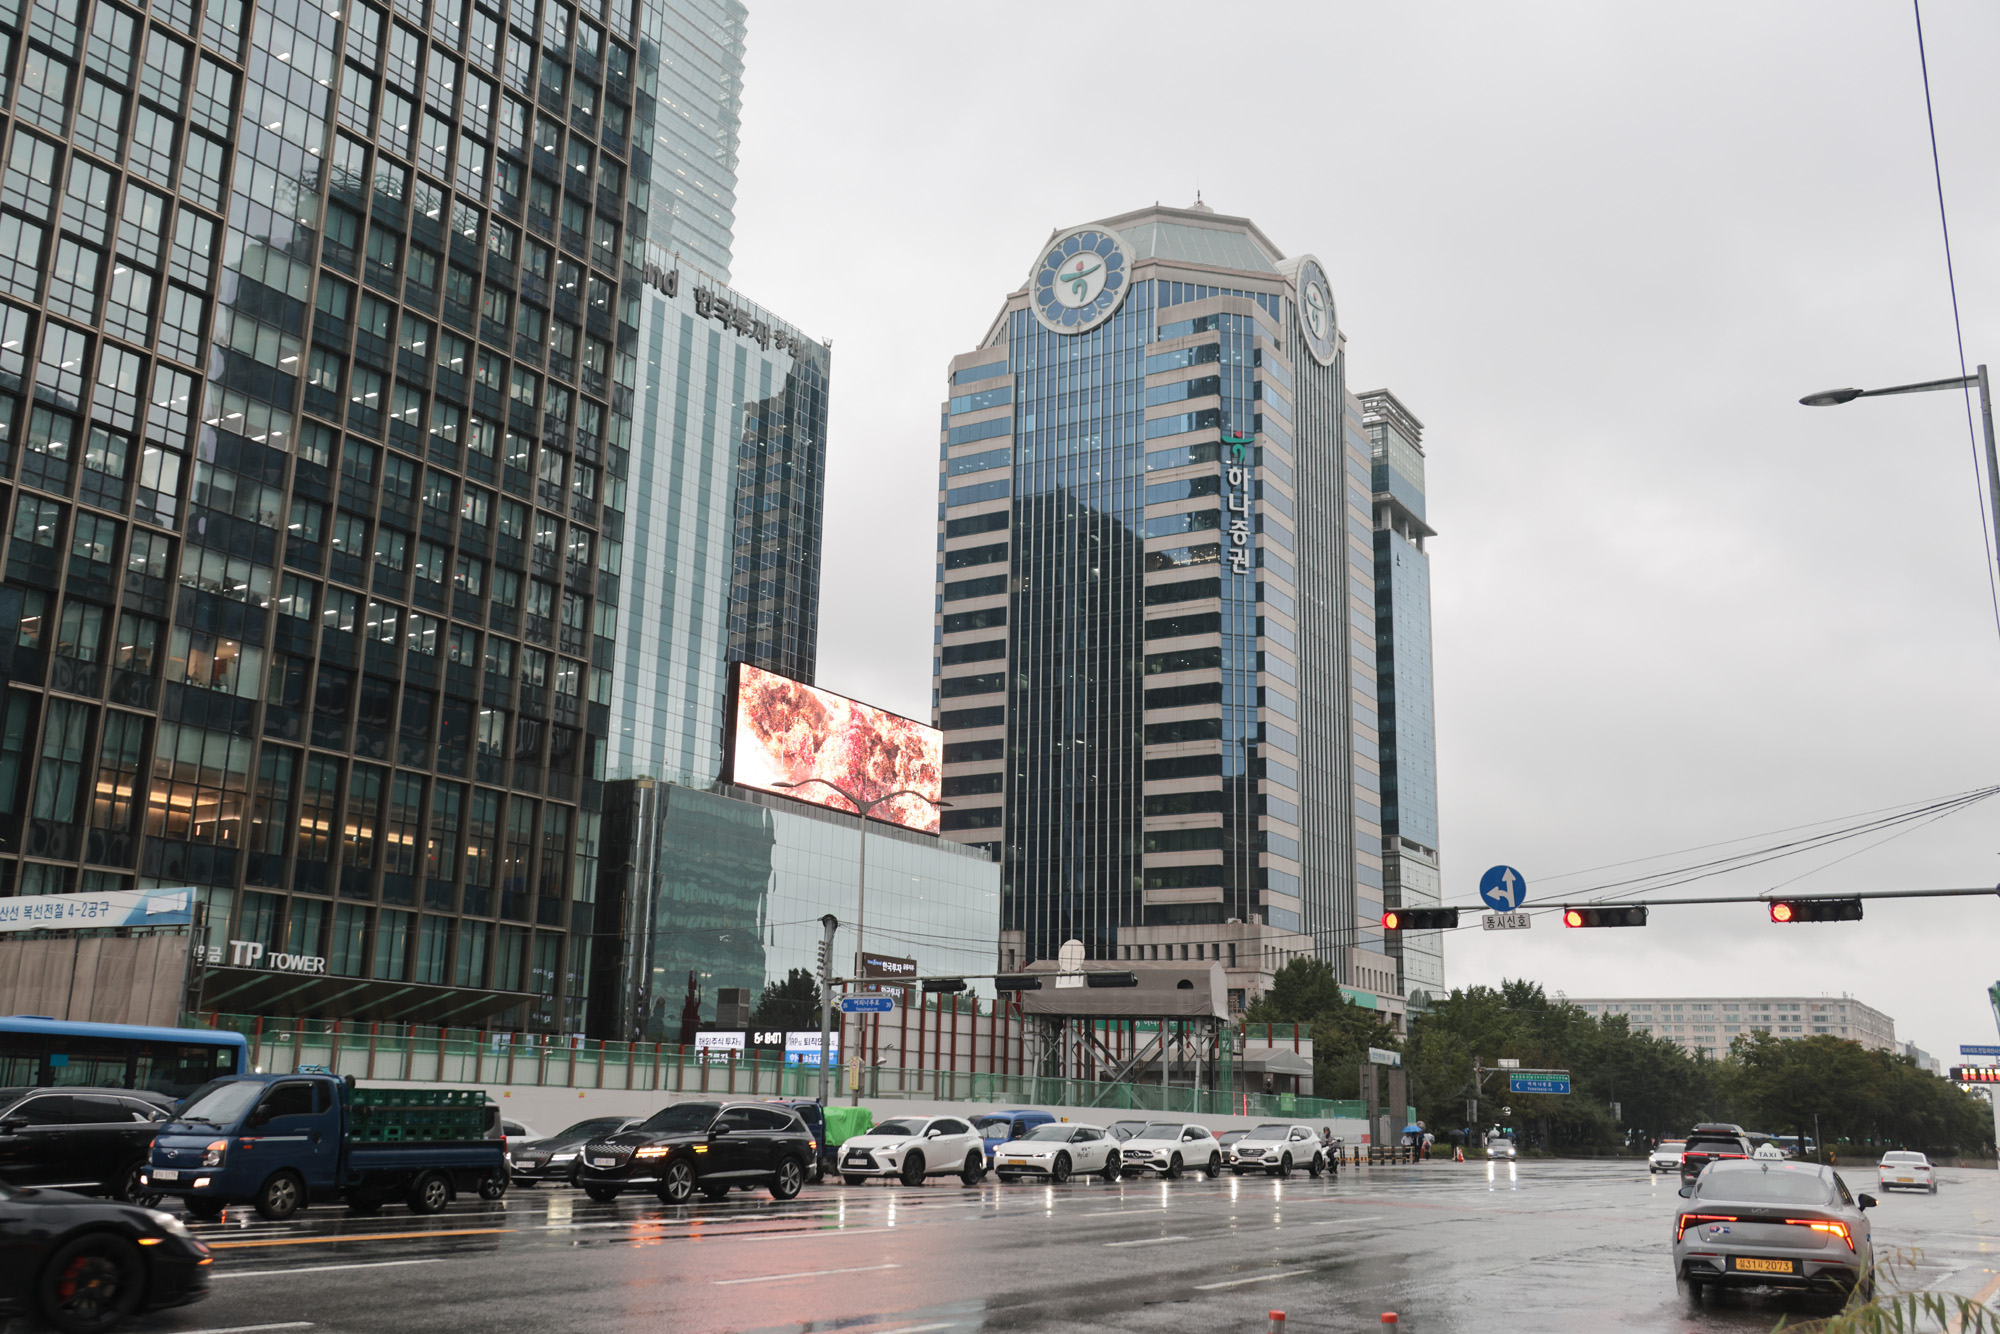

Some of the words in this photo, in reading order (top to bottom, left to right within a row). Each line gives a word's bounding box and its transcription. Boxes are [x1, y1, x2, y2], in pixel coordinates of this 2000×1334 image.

[692, 285, 772, 352] 한국투자
[1227, 466, 1252, 575] 하나증권
[23, 902, 65, 920] 복선전철
[67, 901, 109, 918] 4-2공구
[1486, 915, 1527, 929] 동시신호
[229, 940, 264, 967] TP
[267, 951, 326, 973] TOWER
[1758, 1151, 1778, 1159] TAXI
[1765, 1260, 1790, 1271] 2073
